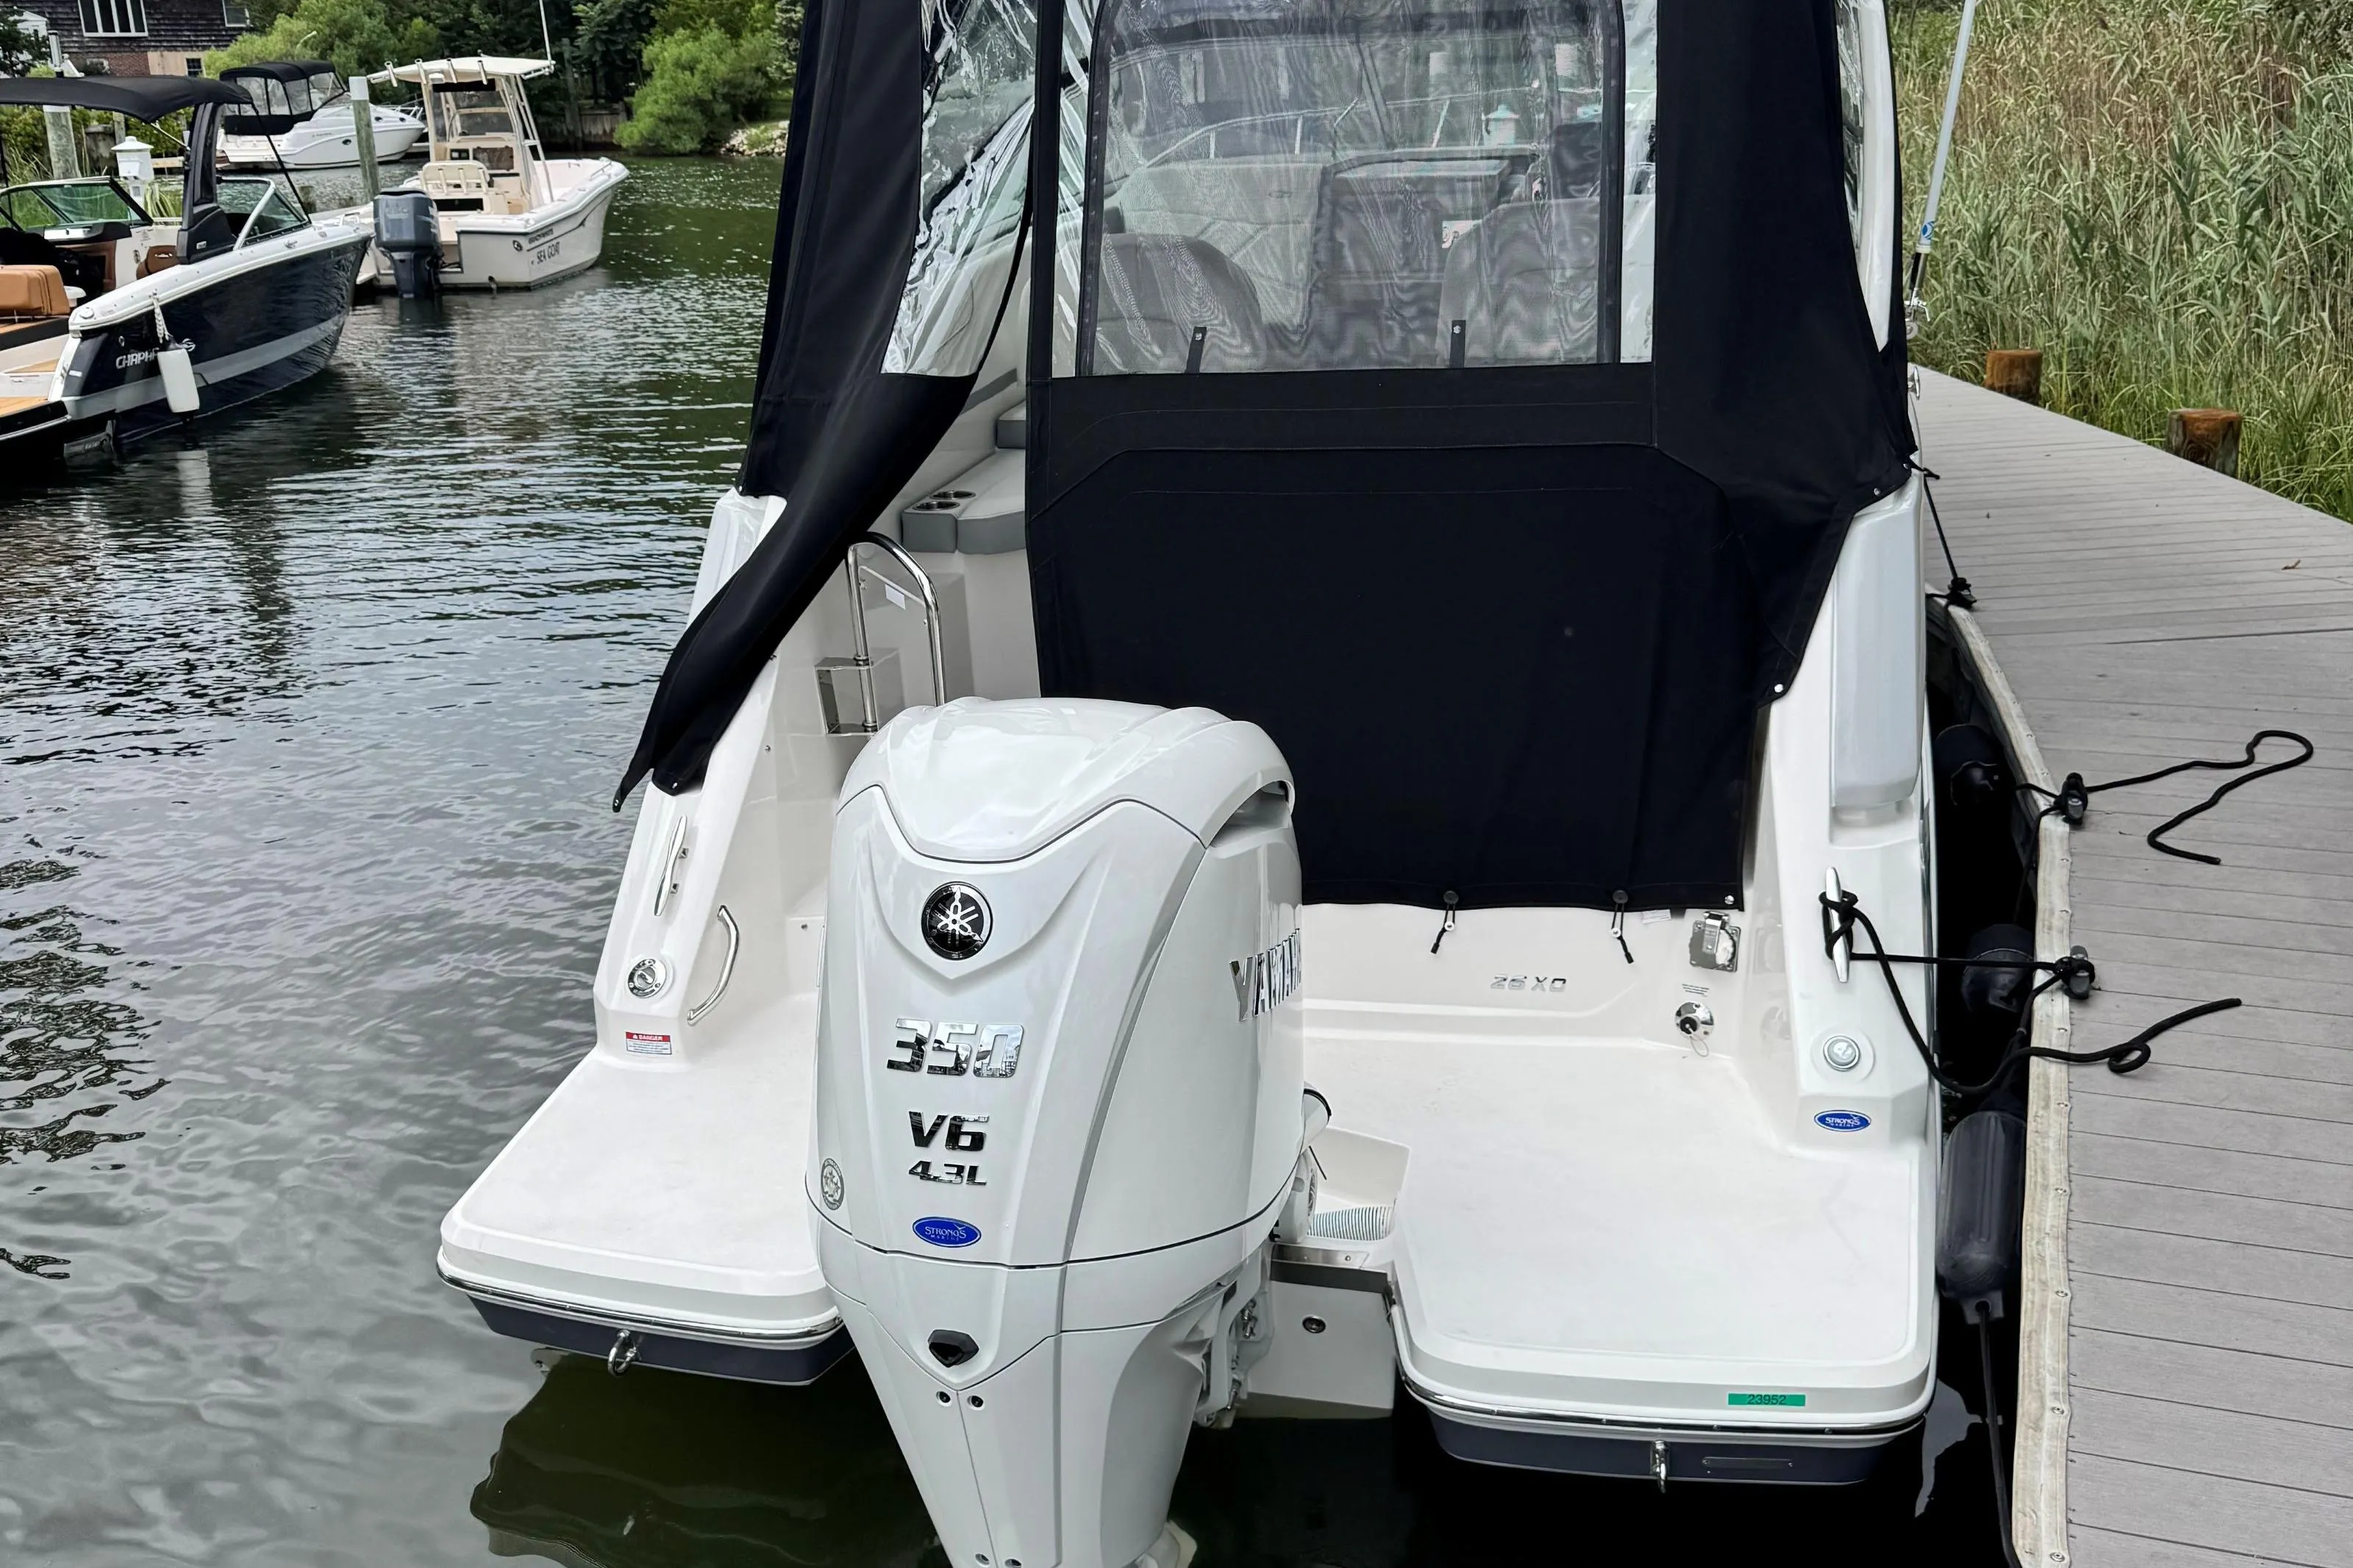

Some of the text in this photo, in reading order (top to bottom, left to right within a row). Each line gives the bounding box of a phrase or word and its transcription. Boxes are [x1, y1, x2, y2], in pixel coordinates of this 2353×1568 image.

[887, 1018, 1024, 1078] 350
[909, 1111, 989, 1152] V6
[908, 1160, 987, 1186] 4.3L
[1746, 1394, 1787, 1406] 23952
